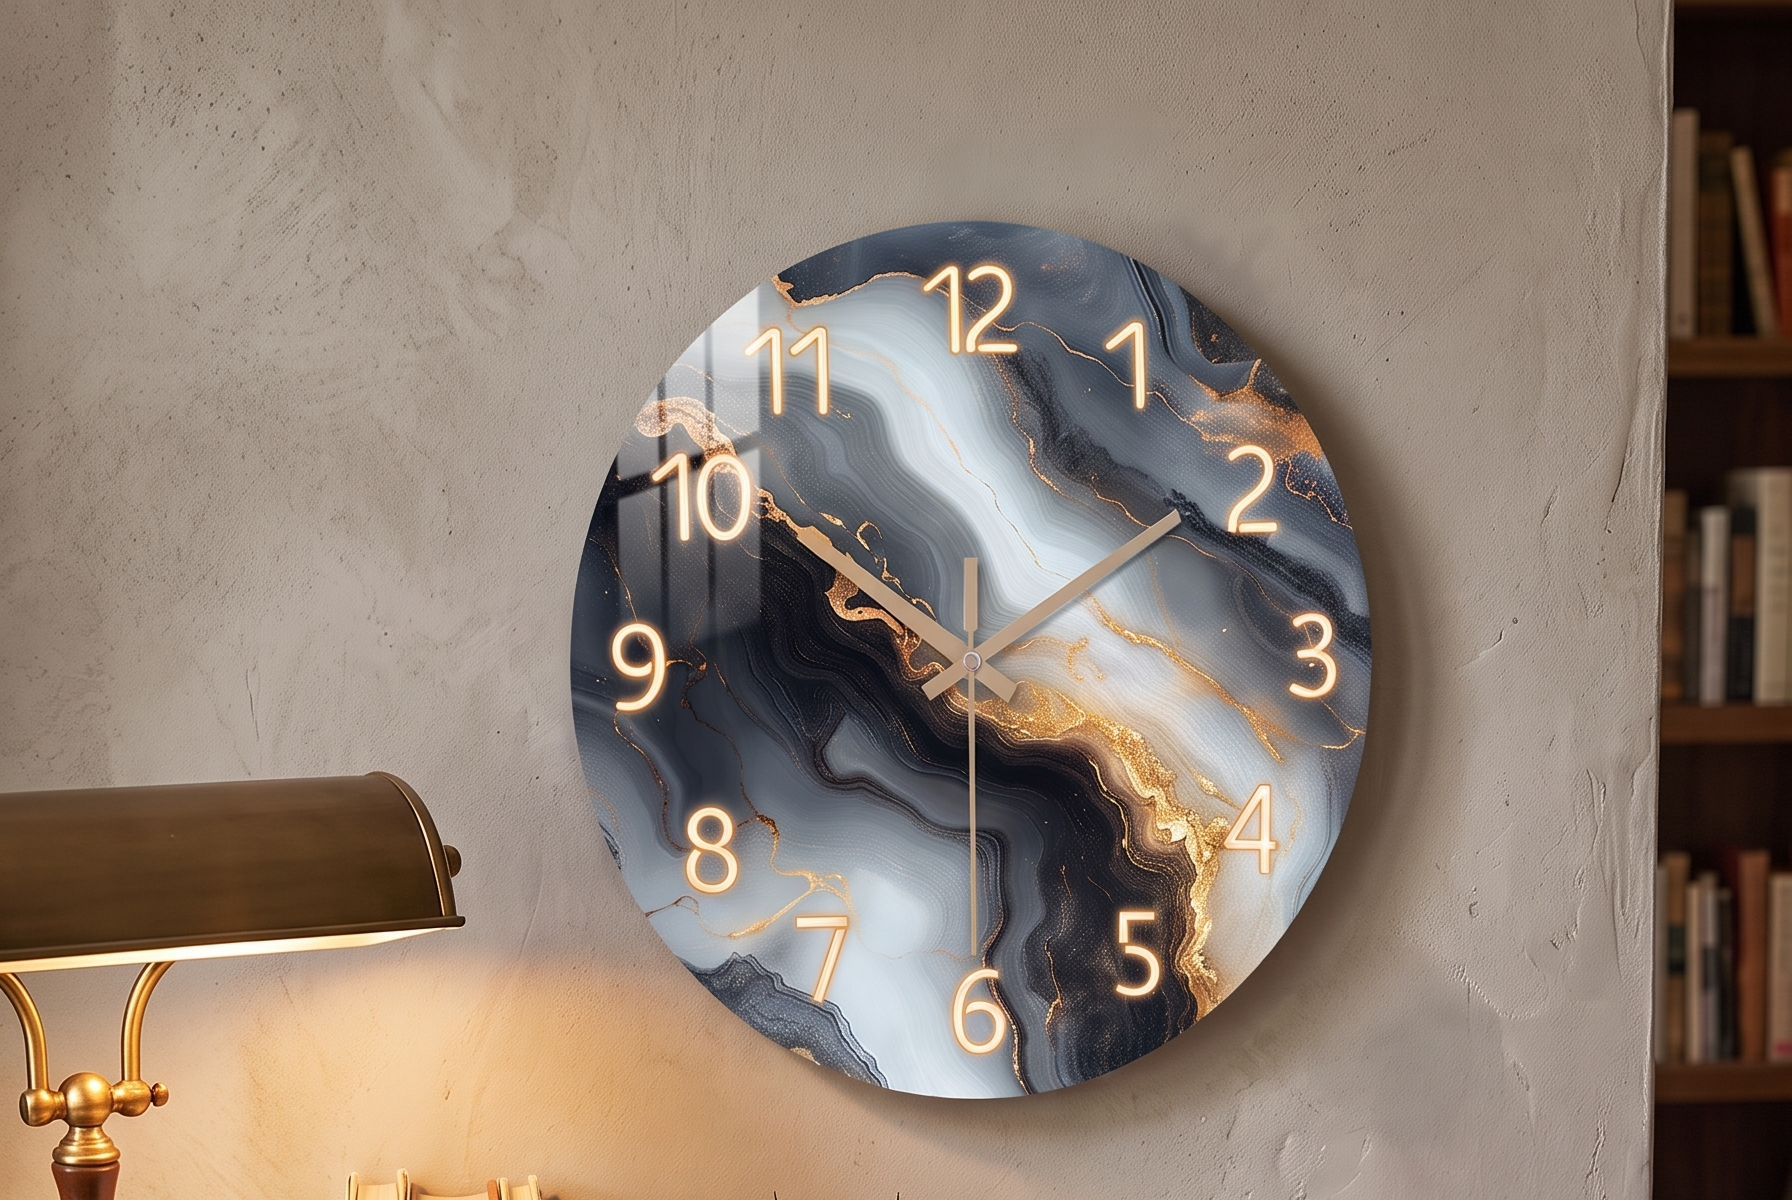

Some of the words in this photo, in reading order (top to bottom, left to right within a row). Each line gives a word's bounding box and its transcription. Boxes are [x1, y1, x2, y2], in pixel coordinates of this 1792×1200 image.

[924, 265, 1017, 354] 12
[745, 327, 829, 415] 11
[1105, 322, 1147, 410] 1
[652, 452, 752, 541] 10
[1227, 444, 1279, 534] 2
[609, 623, 666, 713] 9
[1289, 613, 1339, 698] 3
[685, 807, 741, 895] 8
[1224, 784, 1279, 874] 4
[795, 915, 848, 1002] 7
[1115, 911, 1161, 996] 5
[952, 968, 1006, 1055] 6
